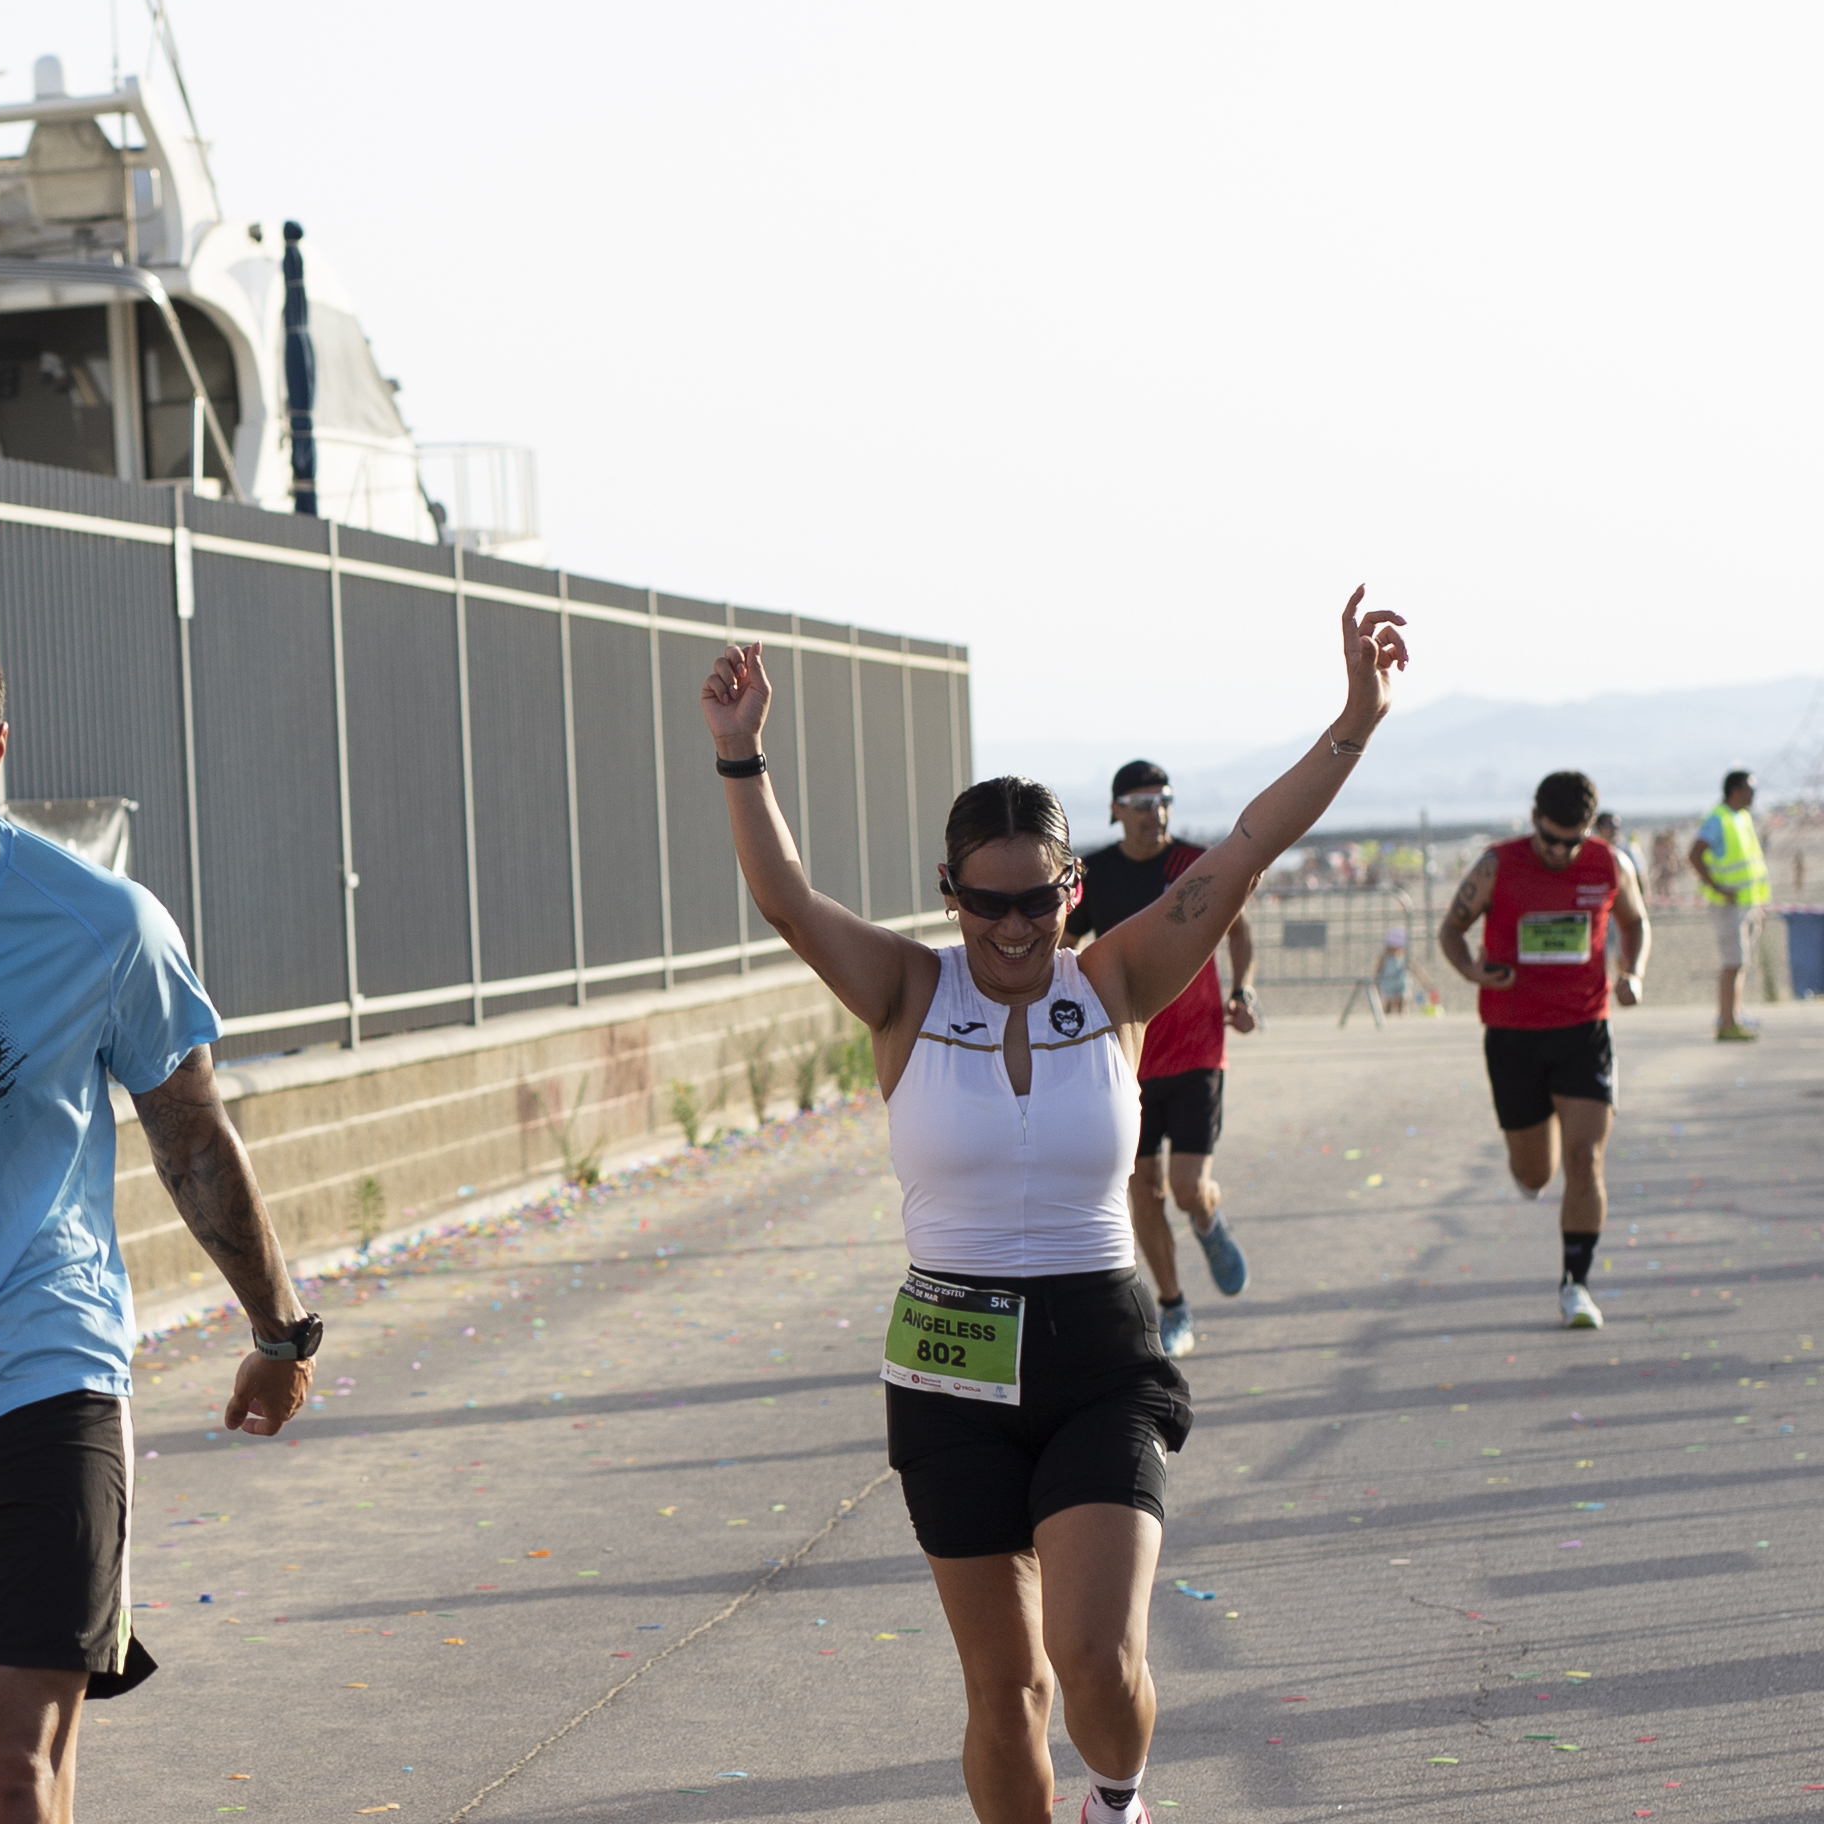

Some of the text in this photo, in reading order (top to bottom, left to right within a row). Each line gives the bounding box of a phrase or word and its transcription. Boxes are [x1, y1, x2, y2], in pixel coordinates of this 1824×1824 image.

[990, 1296, 1010, 1309] 5K
[901, 1307, 996, 1342] ANGELESS
[916, 1338, 967, 1368] 802
